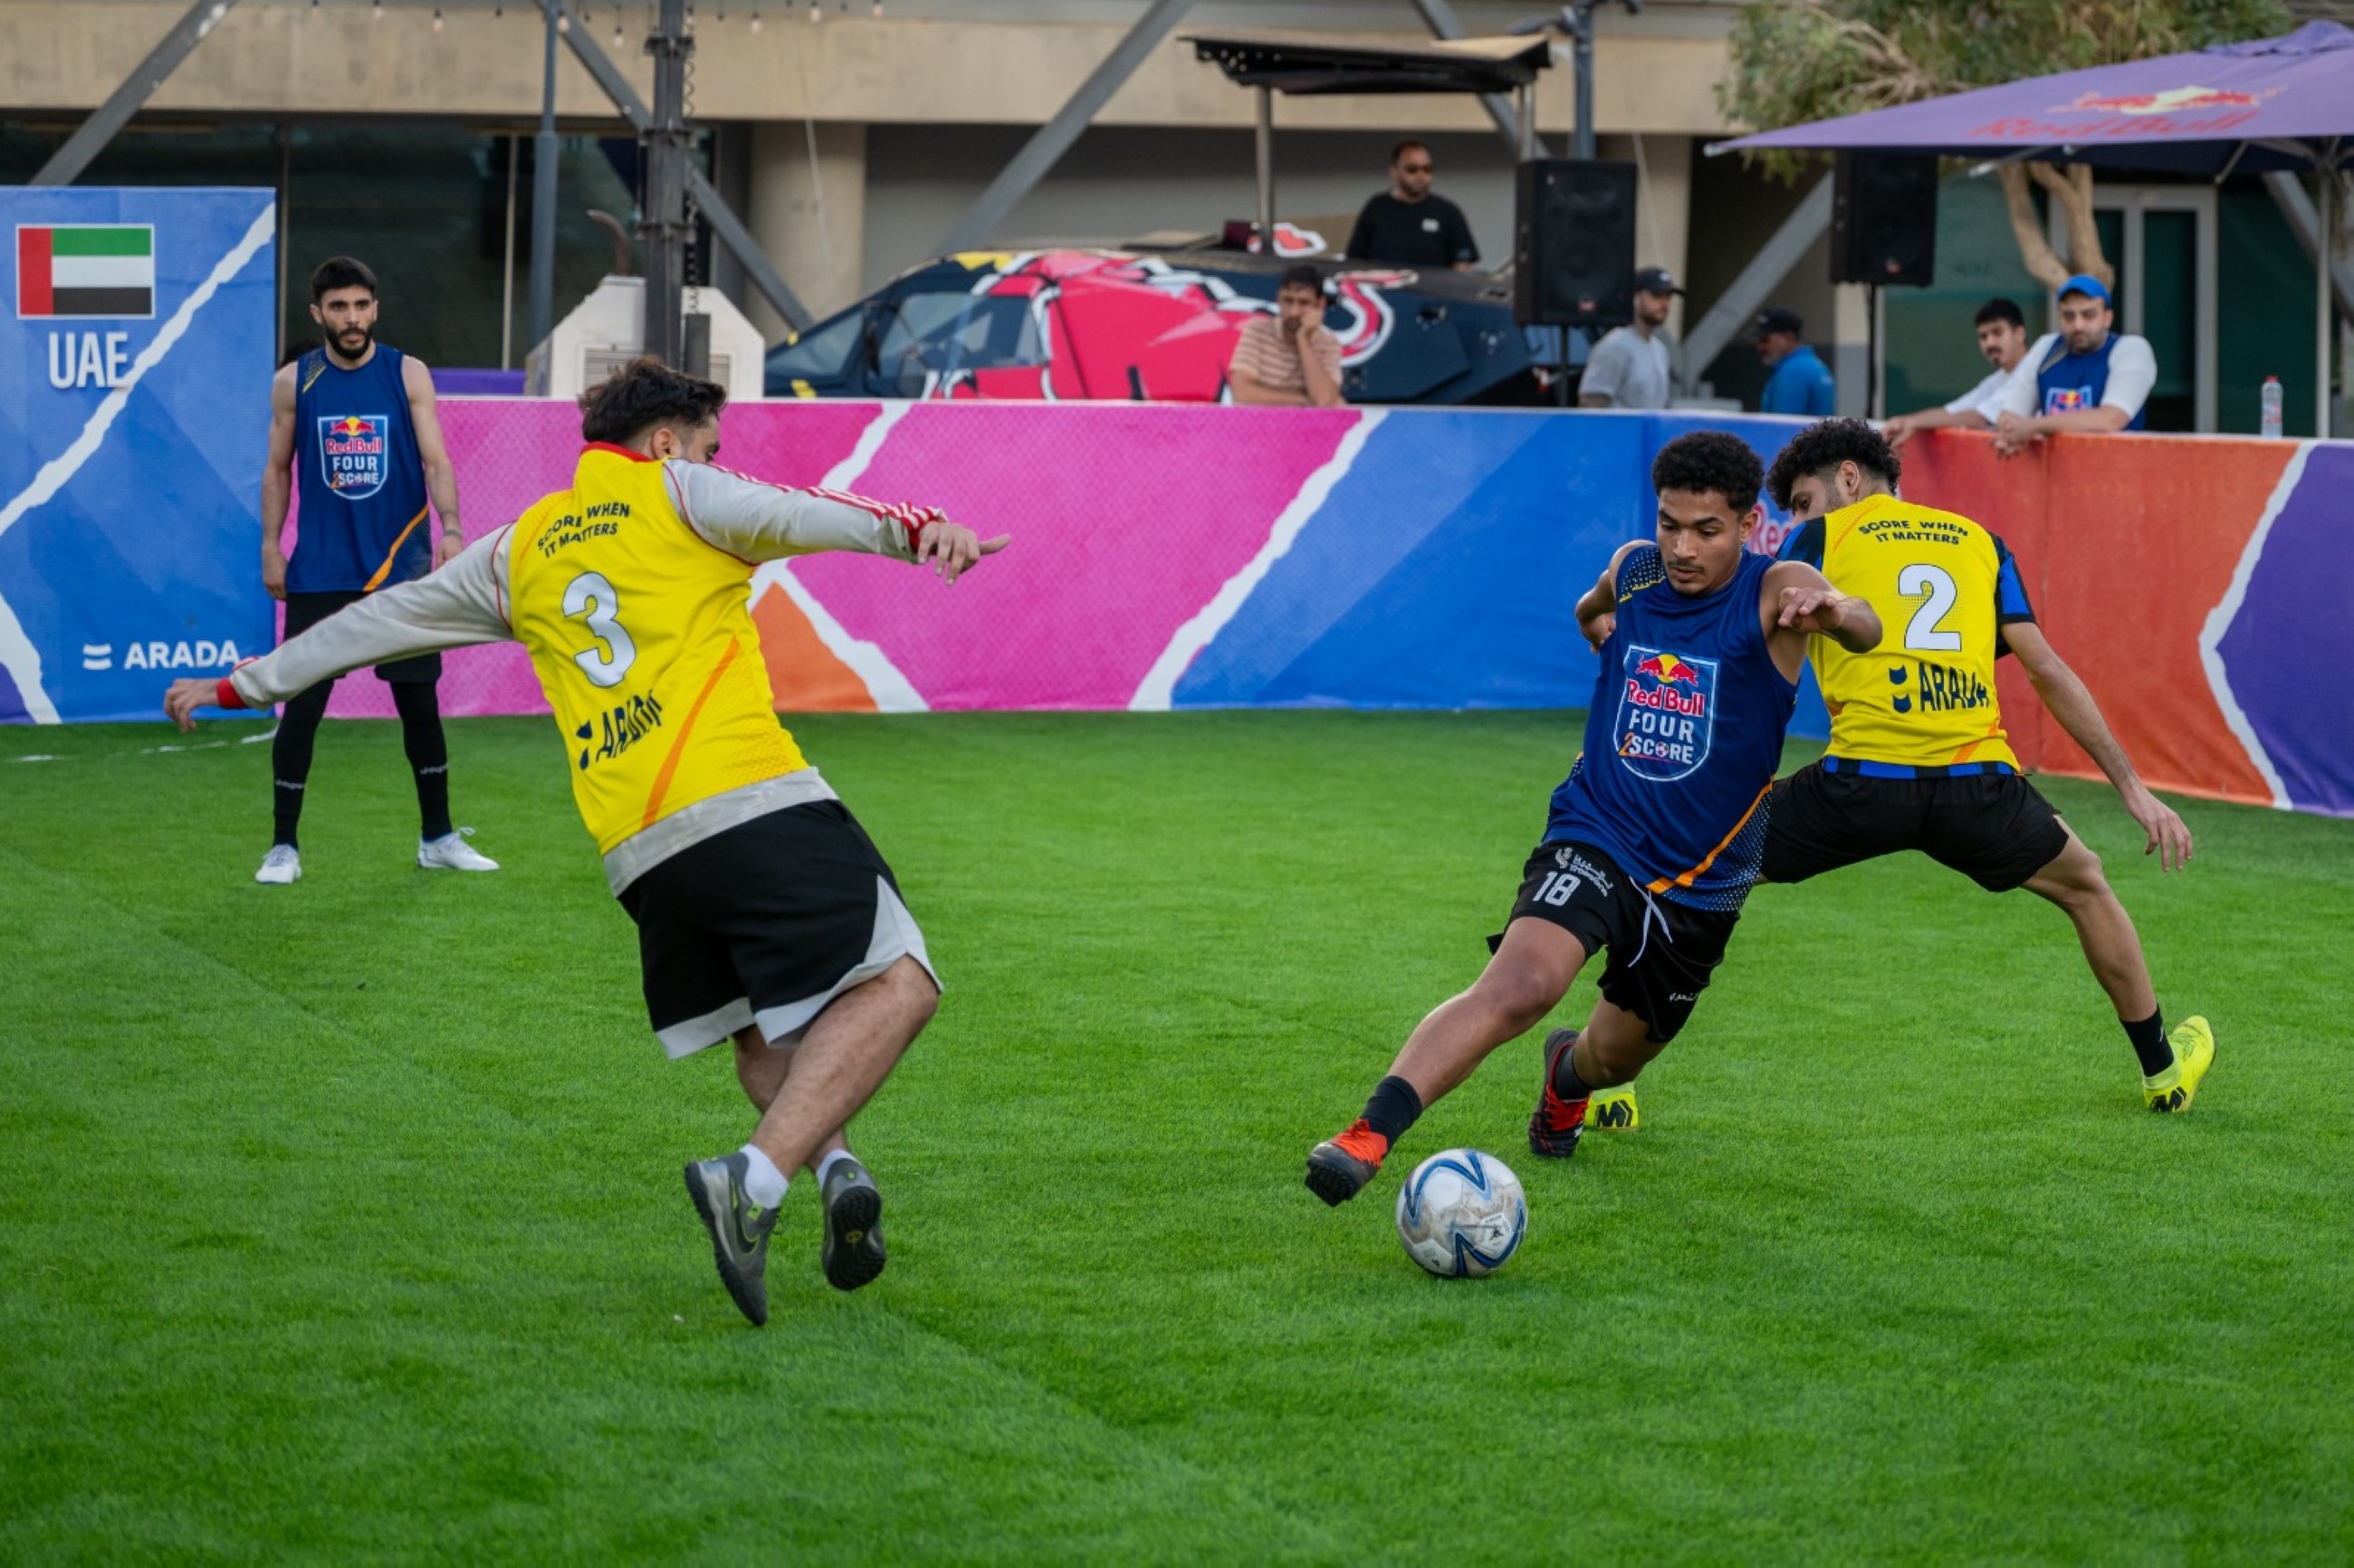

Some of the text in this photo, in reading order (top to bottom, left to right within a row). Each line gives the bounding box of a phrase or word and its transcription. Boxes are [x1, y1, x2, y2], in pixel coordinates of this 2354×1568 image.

[49, 331, 129, 389] UAE
[325, 436, 382, 455] Red Bull
[332, 455, 378, 472] FOUR
[537, 502, 630, 550] SCORE WHEN
[545, 522, 617, 559] IT MATTERS
[1749, 502, 1794, 559] Re
[1859, 520, 1968, 536] SCORE WHEN
[1876, 531, 1959, 545] IT MATTERS
[1898, 563, 1962, 652] 2
[561, 570, 636, 688] 3
[123, 639, 241, 671] ARADA
[1627, 678, 1705, 718] Red Bull
[1629, 709, 1695, 744] FOUR
[1532, 870, 1582, 906] 18
